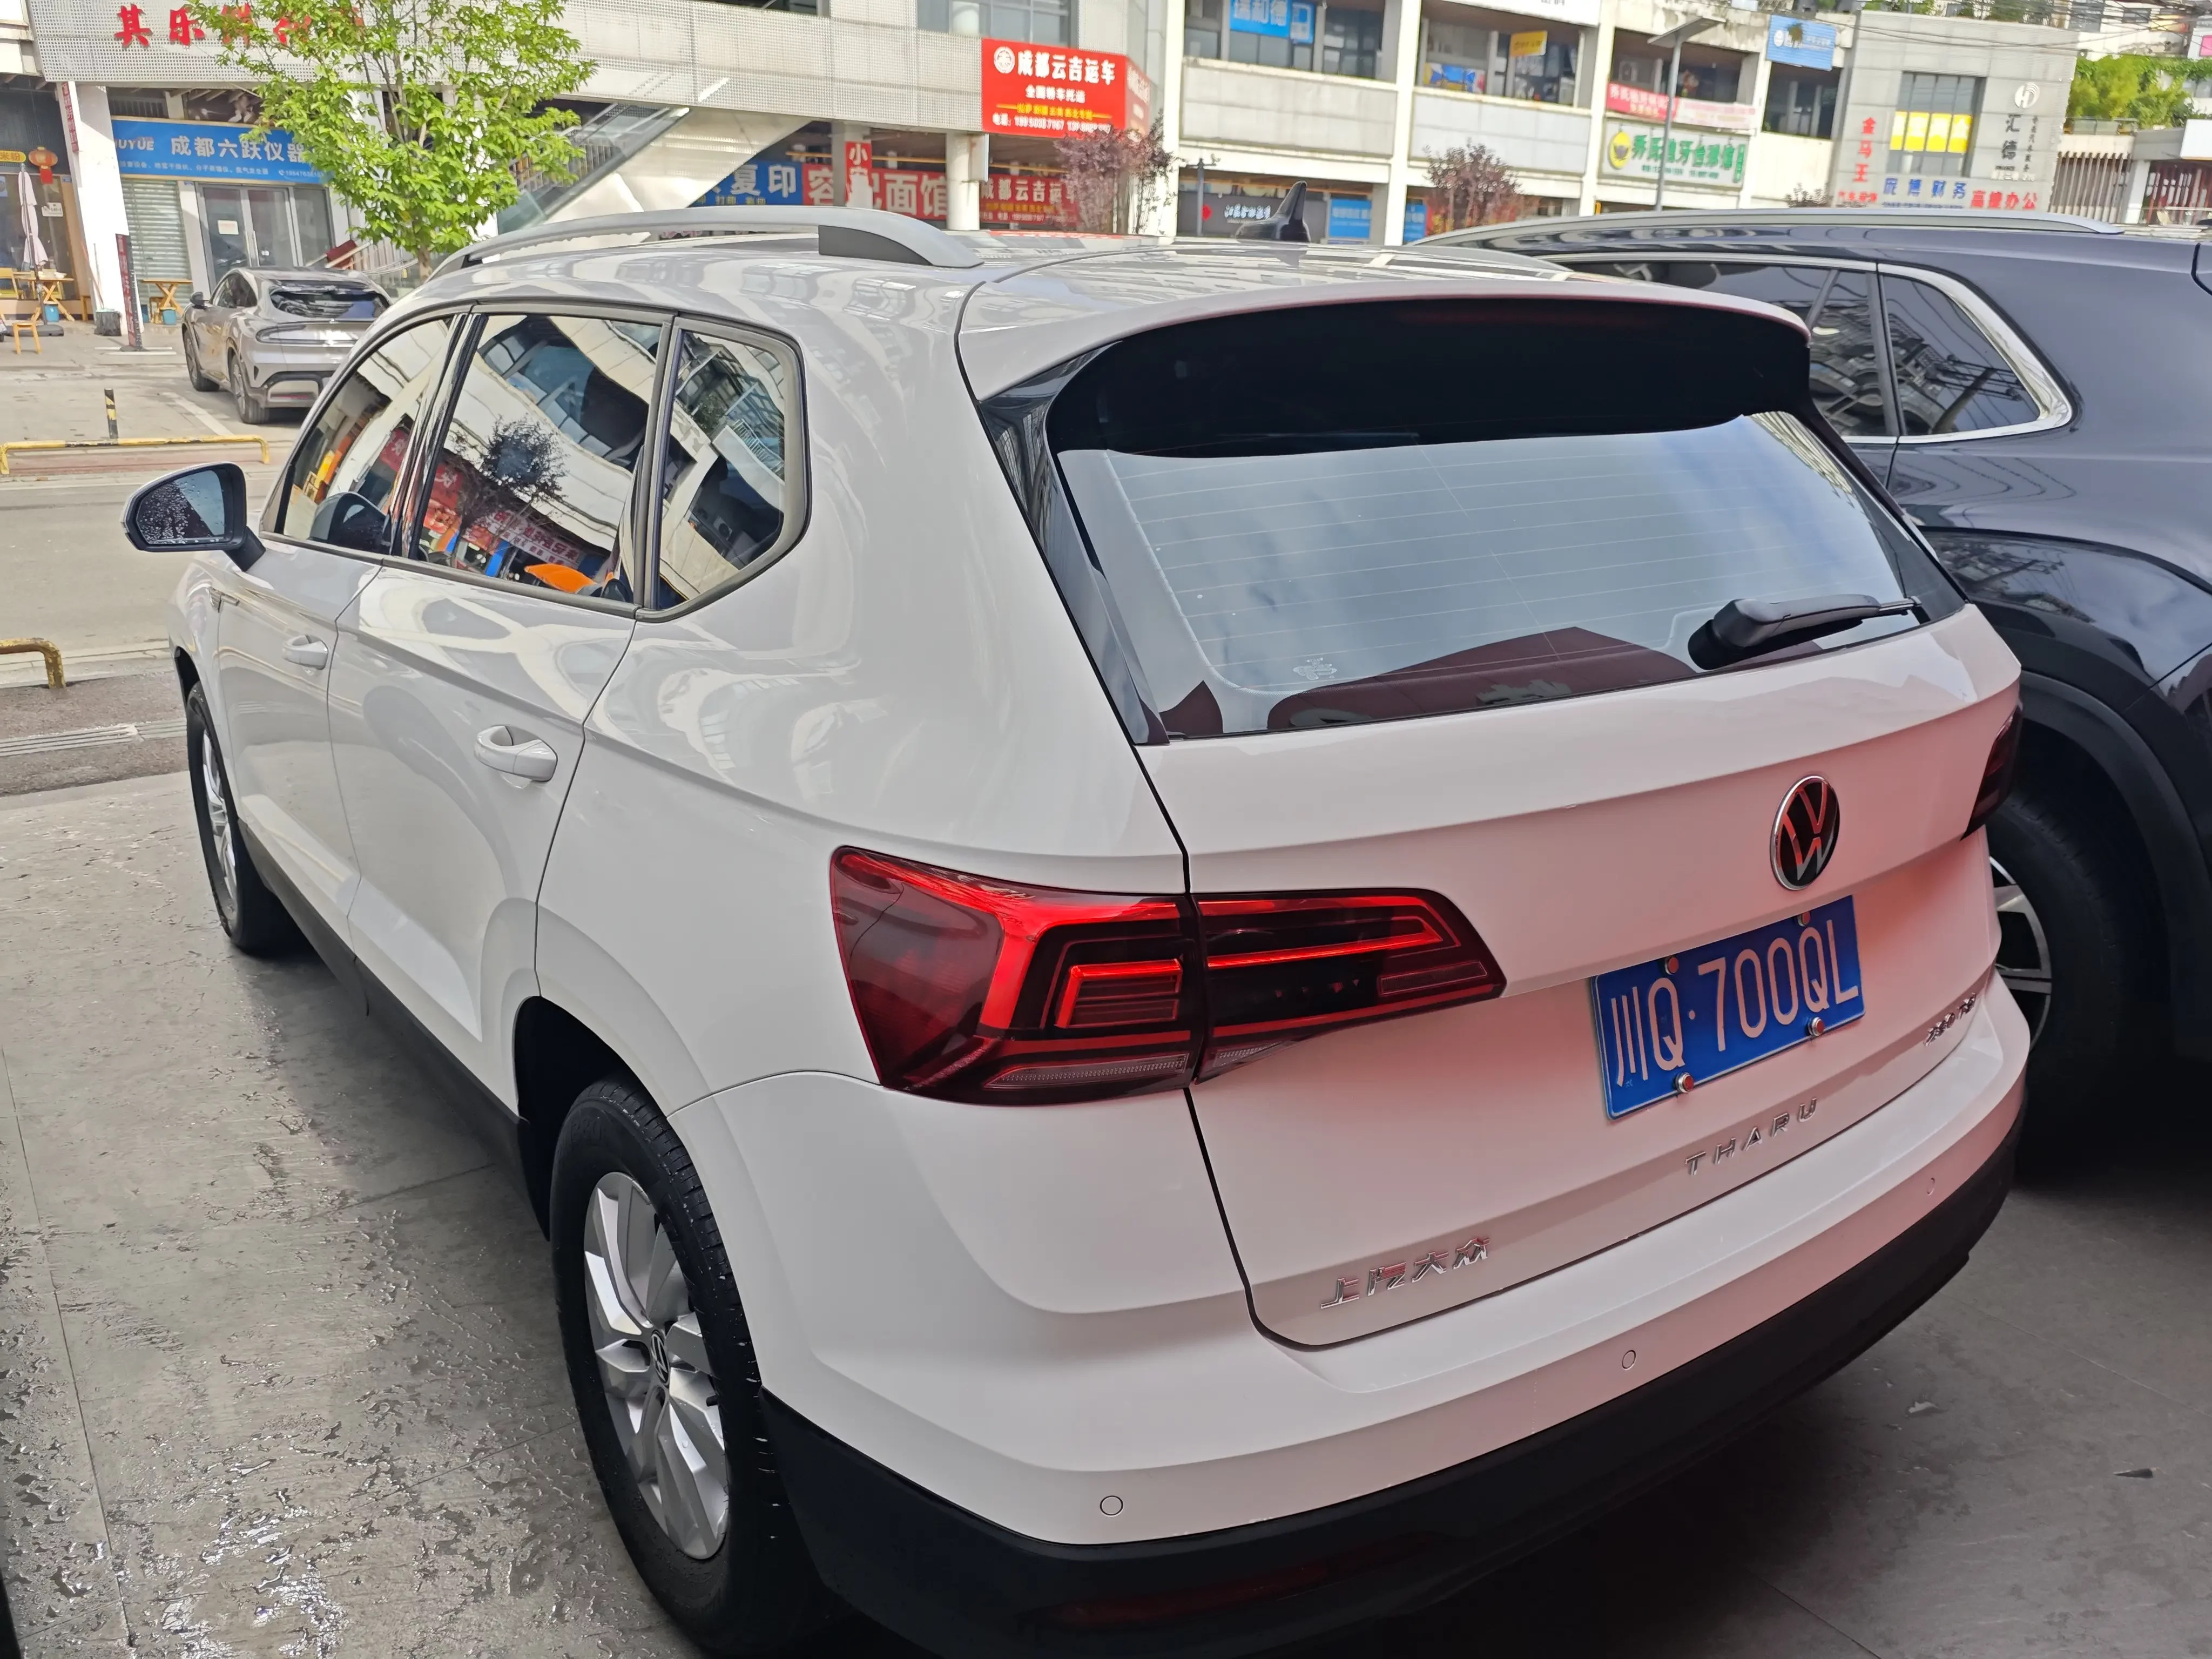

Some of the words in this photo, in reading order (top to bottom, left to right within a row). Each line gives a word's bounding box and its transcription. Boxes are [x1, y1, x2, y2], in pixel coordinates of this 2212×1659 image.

[1017, 49, 1115, 85] 成都云吉运车
[171, 136, 306, 163] 成都六跃仪器
[1852, 116, 1876, 183] 金马王
[712, 164, 797, 198] 复印
[1684, 1097, 1818, 1176] THARU
[1320, 1237, 1491, 1310] 上汽大众
